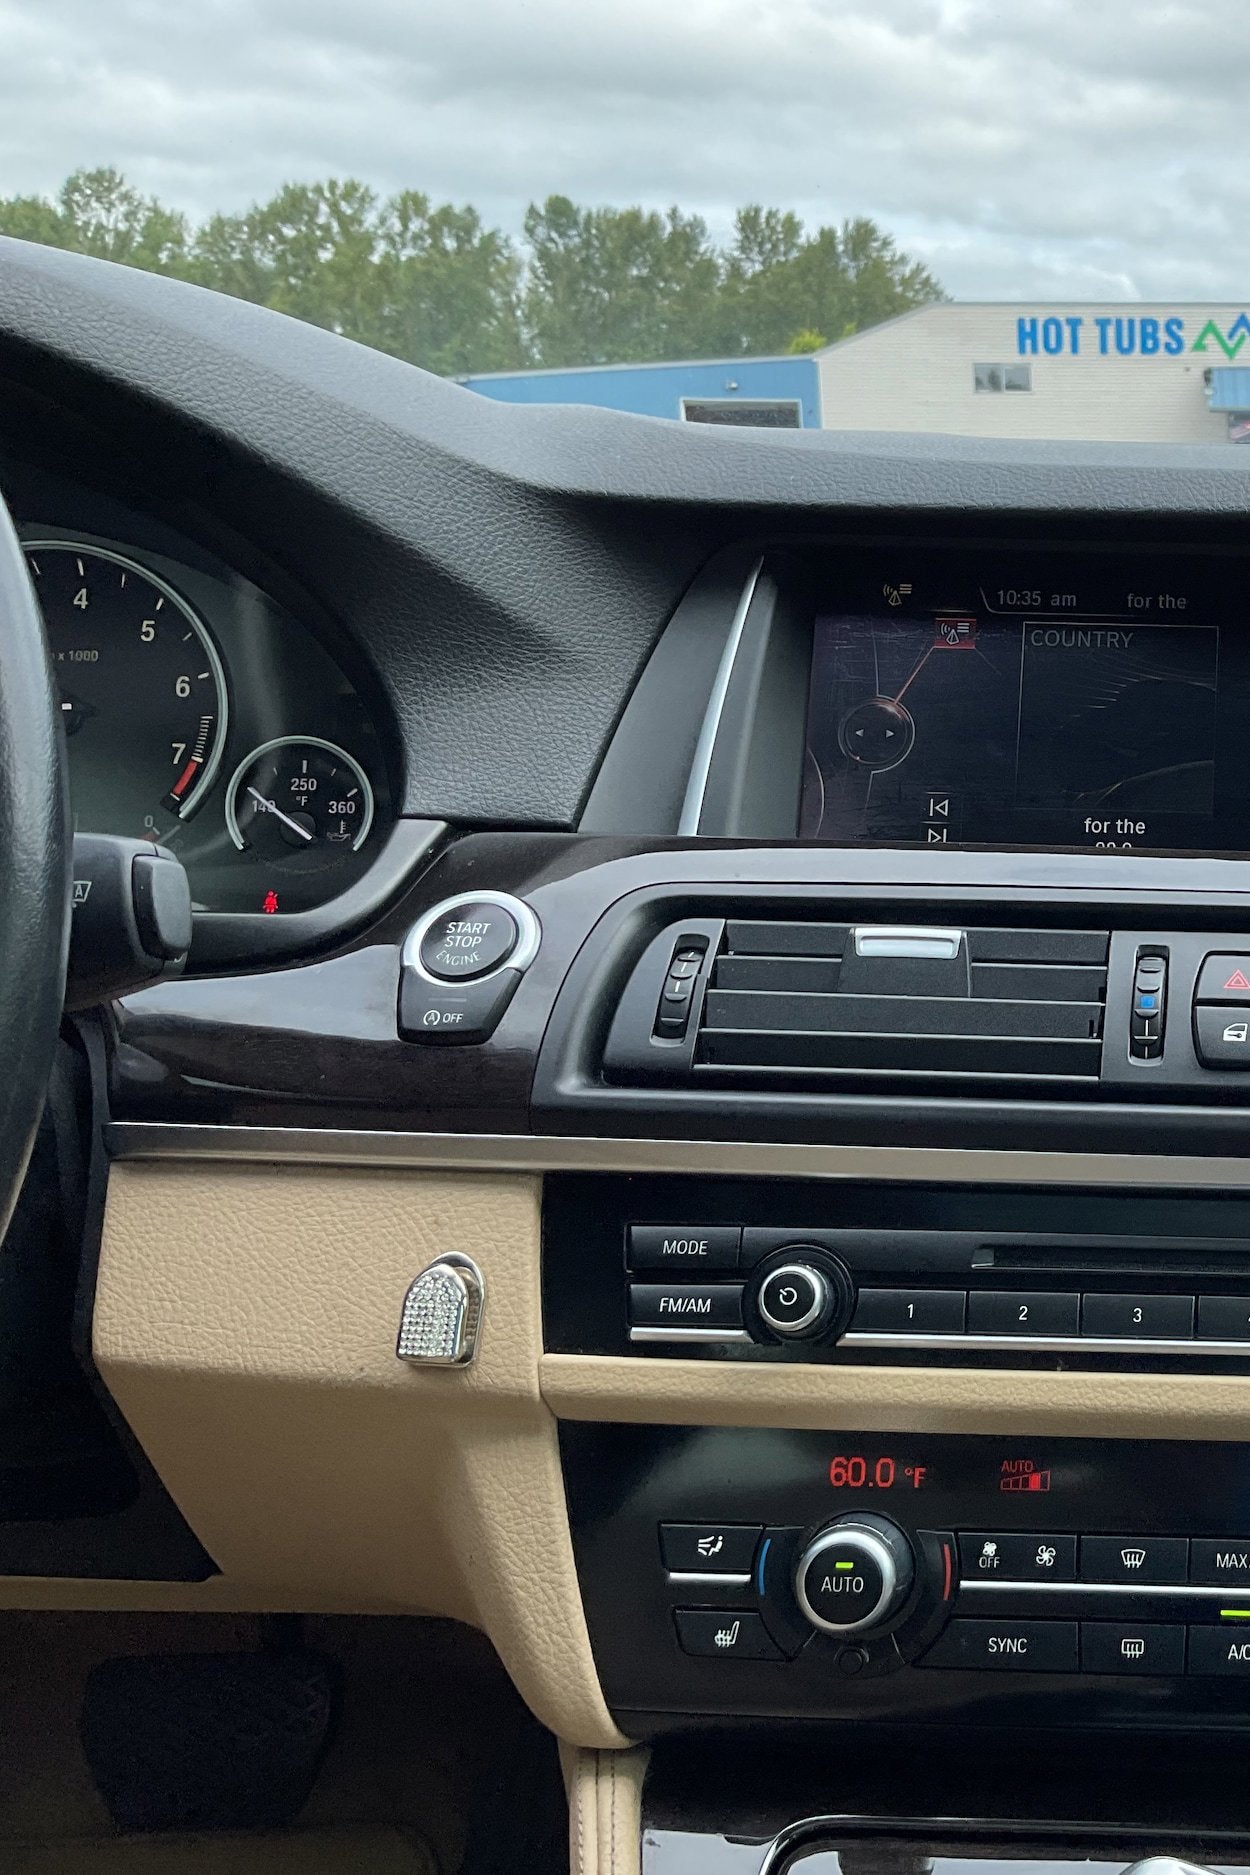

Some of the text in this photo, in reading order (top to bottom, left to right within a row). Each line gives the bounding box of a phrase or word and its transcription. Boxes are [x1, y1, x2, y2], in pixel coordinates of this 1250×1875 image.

[1016, 317, 1081, 355] HOT
[1096, 317, 1184, 355] TUBS
[73, 588, 88, 609] 4
[997, 591, 1077, 606] 10:35 am
[1127, 594, 1187, 609] for the
[140, 620, 155, 641] 5
[1031, 630, 1134, 648] COUNTRY
[68, 651, 98, 661] 1000
[175, 676, 190, 697] 6
[171, 743, 186, 765] 7
[290, 778, 317, 790] 250
[328, 801, 355, 813] 360
[1084, 817, 1145, 834] for the
[446, 922, 491, 934] START
[444, 936, 482, 948] STOP
[436, 951, 481, 965] ENGINE
[442, 1013, 463, 1023] OFF
[662, 1241, 708, 1255] MODE
[659, 1297, 711, 1313] FM/AM
[907, 1304, 914, 1319] 1
[1018, 1305, 1029, 1320] 2
[1132, 1308, 1143, 1323] 3
[829, 1456, 895, 1489] 60.0
[1001, 1460, 1033, 1473] AUTO
[979, 1556, 1000, 1569] OFF
[1216, 1553, 1248, 1568] MAX
[821, 1576, 864, 1593] AUTO
[988, 1638, 1027, 1653] SYNC
